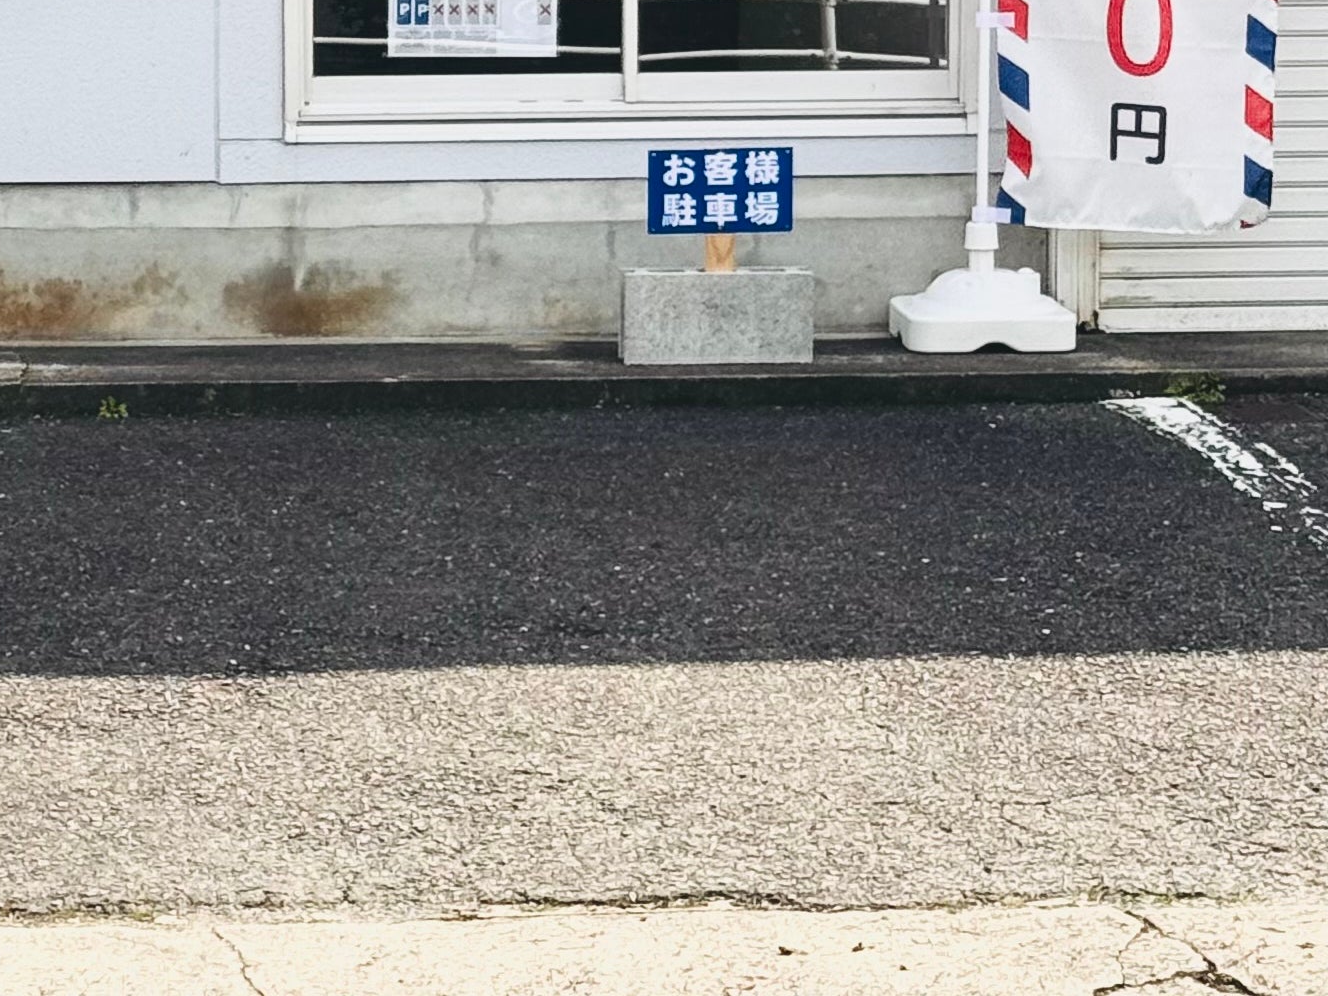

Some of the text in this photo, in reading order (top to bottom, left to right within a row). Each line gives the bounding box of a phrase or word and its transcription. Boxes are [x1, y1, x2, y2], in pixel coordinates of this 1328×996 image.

[662, 150, 780, 187] お客様
[661, 191, 780, 229] 駐車場
